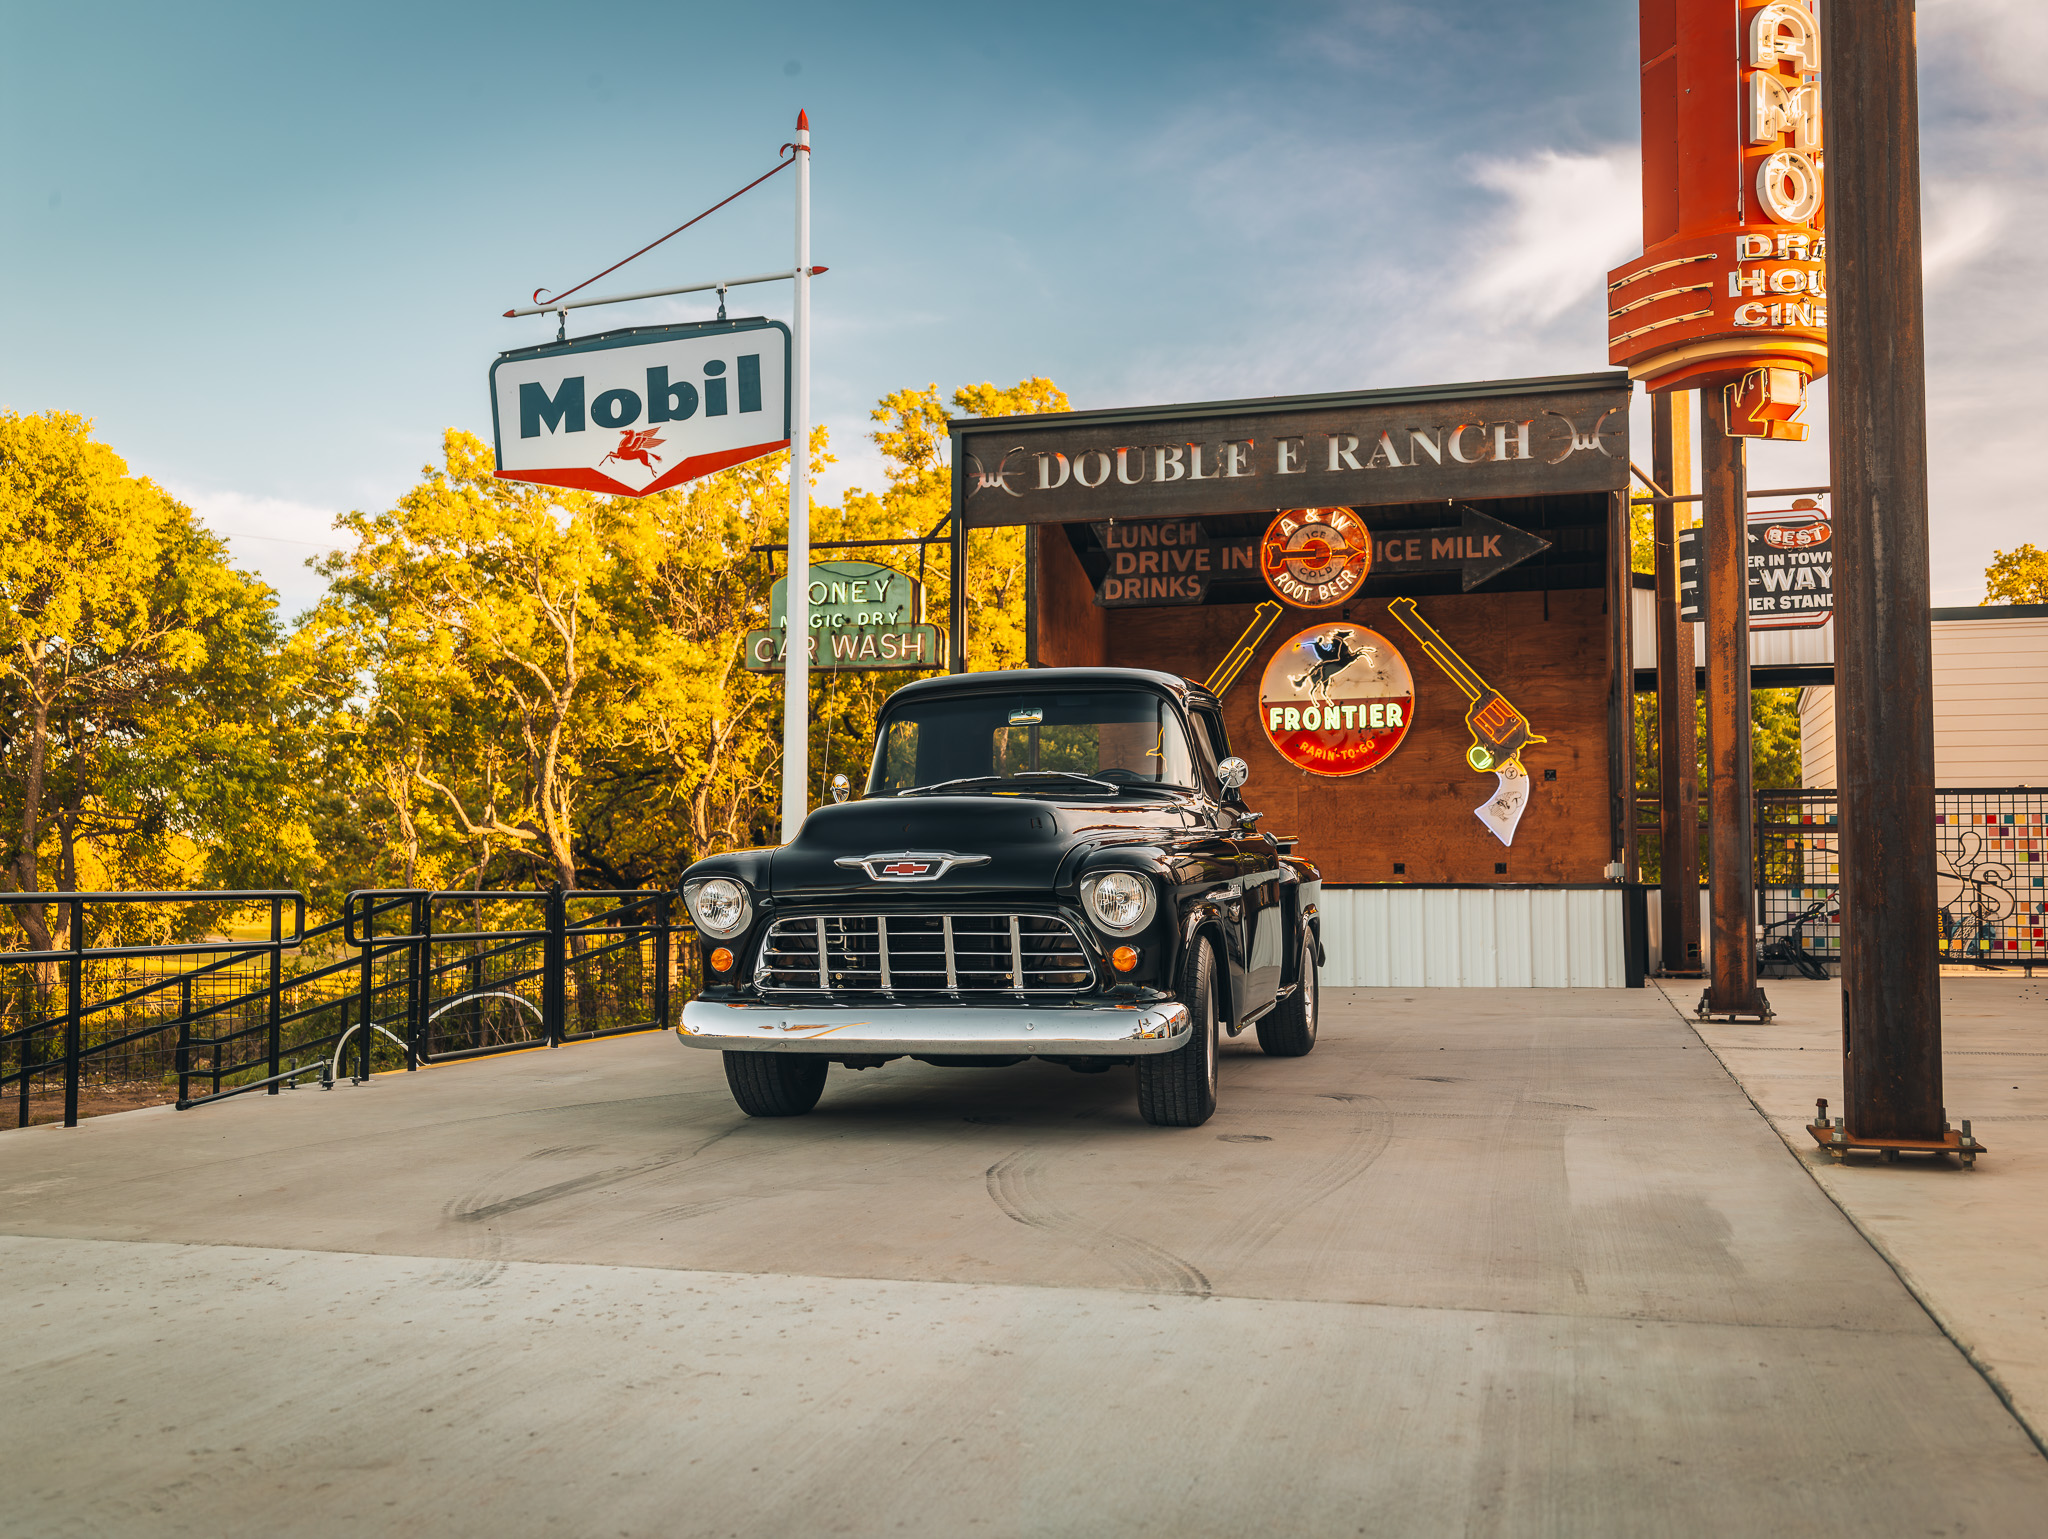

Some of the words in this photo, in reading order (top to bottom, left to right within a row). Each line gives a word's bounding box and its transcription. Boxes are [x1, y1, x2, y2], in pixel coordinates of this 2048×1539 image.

[519, 353, 762, 439] Mobil
[1030, 438, 1256, 490] DOUBLE
[1273, 434, 1308, 475] E
[1323, 419, 1534, 472] RANCH
[1106, 522, 1197, 549] LUNCH
[1280, 518, 1299, 536] A
[1305, 508, 1321, 523] &
[1330, 510, 1352, 531] W
[1306, 530, 1327, 539] ICE
[1767, 525, 1824, 546] BEST
[1116, 548, 1211, 575] DRIVE
[1222, 546, 1253, 570] IN
[1376, 539, 1422, 563] ICE
[1431, 534, 1502, 560] MILK
[1769, 554, 1785, 567] IN
[1274, 572, 1313, 602] ROOT
[1318, 570, 1357, 600] BEER
[1299, 566, 1333, 578] COLD
[808, 576, 893, 605] ONEY
[1105, 574, 1201, 600] DRINKS
[780, 612, 843, 629] GIC
[858, 611, 898, 626] DRY
[831, 632, 925, 662] WASH
[1269, 703, 1404, 731] FRONTIER
